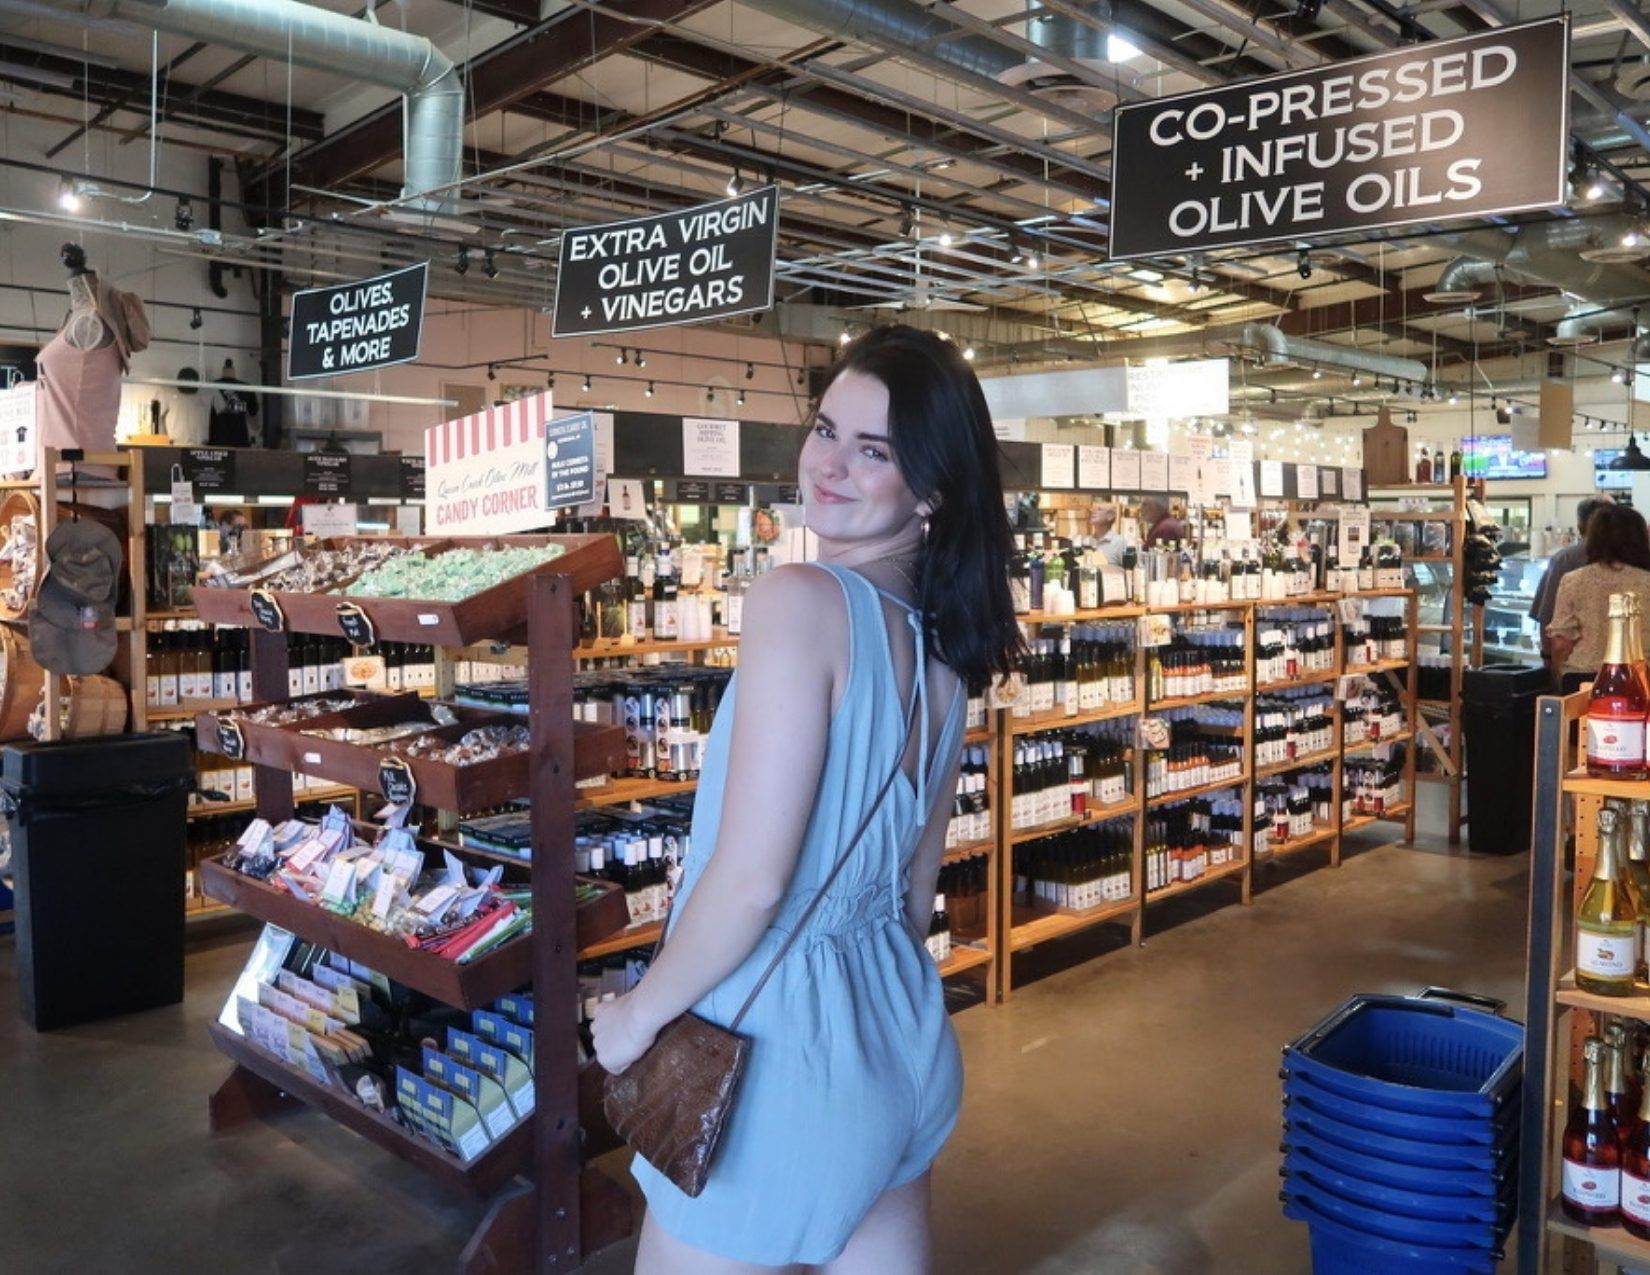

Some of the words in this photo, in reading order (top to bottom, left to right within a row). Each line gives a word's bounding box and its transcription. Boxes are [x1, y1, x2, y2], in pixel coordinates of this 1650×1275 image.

[1149, 45, 1517, 146] CO-PRESSED
[1185, 162, 1204, 181] +
[1221, 108, 1464, 184] INFUSED
[1168, 181, 1325, 238] OLIVE
[1345, 157, 1482, 215] OILS
[569, 224, 668, 262] EXTRA
[678, 197, 769, 244] VIRGIN
[597, 253, 681, 290] OLIVE
[688, 243, 733, 276] OIL
[329, 282, 394, 315] OLIVES,
[580, 305, 592, 320] +
[601, 275, 744, 322] VINEGARS
[306, 303, 411, 345] TAPENADES
[322, 347, 335, 369] &
[339, 336, 392, 367] MORE
[436, 497, 478, 526] CANDY
[482, 485, 539, 517] CORNER
